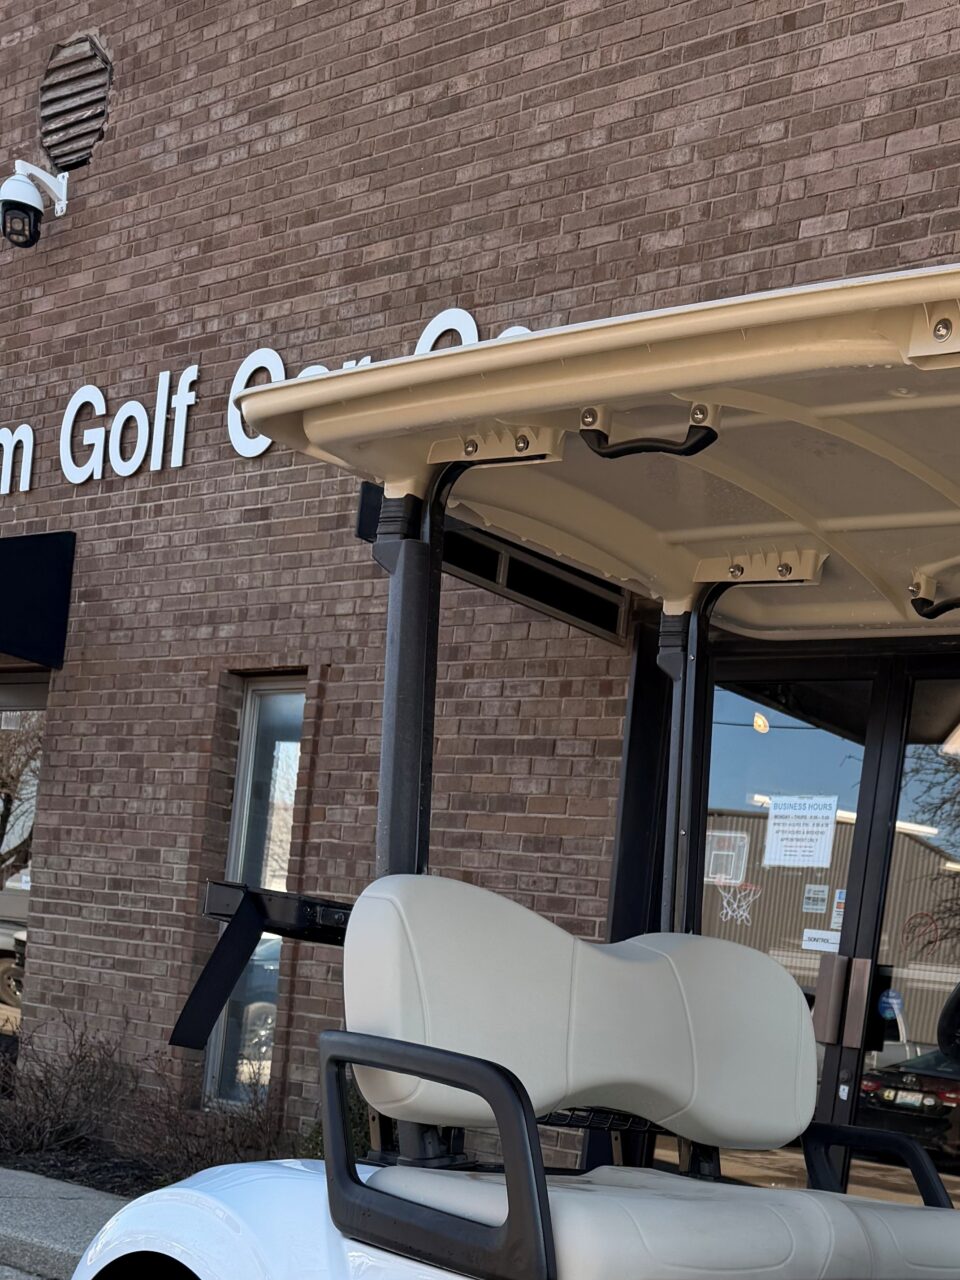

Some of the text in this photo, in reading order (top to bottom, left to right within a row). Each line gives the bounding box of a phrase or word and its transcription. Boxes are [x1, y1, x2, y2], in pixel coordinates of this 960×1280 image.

[60, 365, 198, 485] Golf
[773, 802, 833, 811] BUSINESS HOURS
